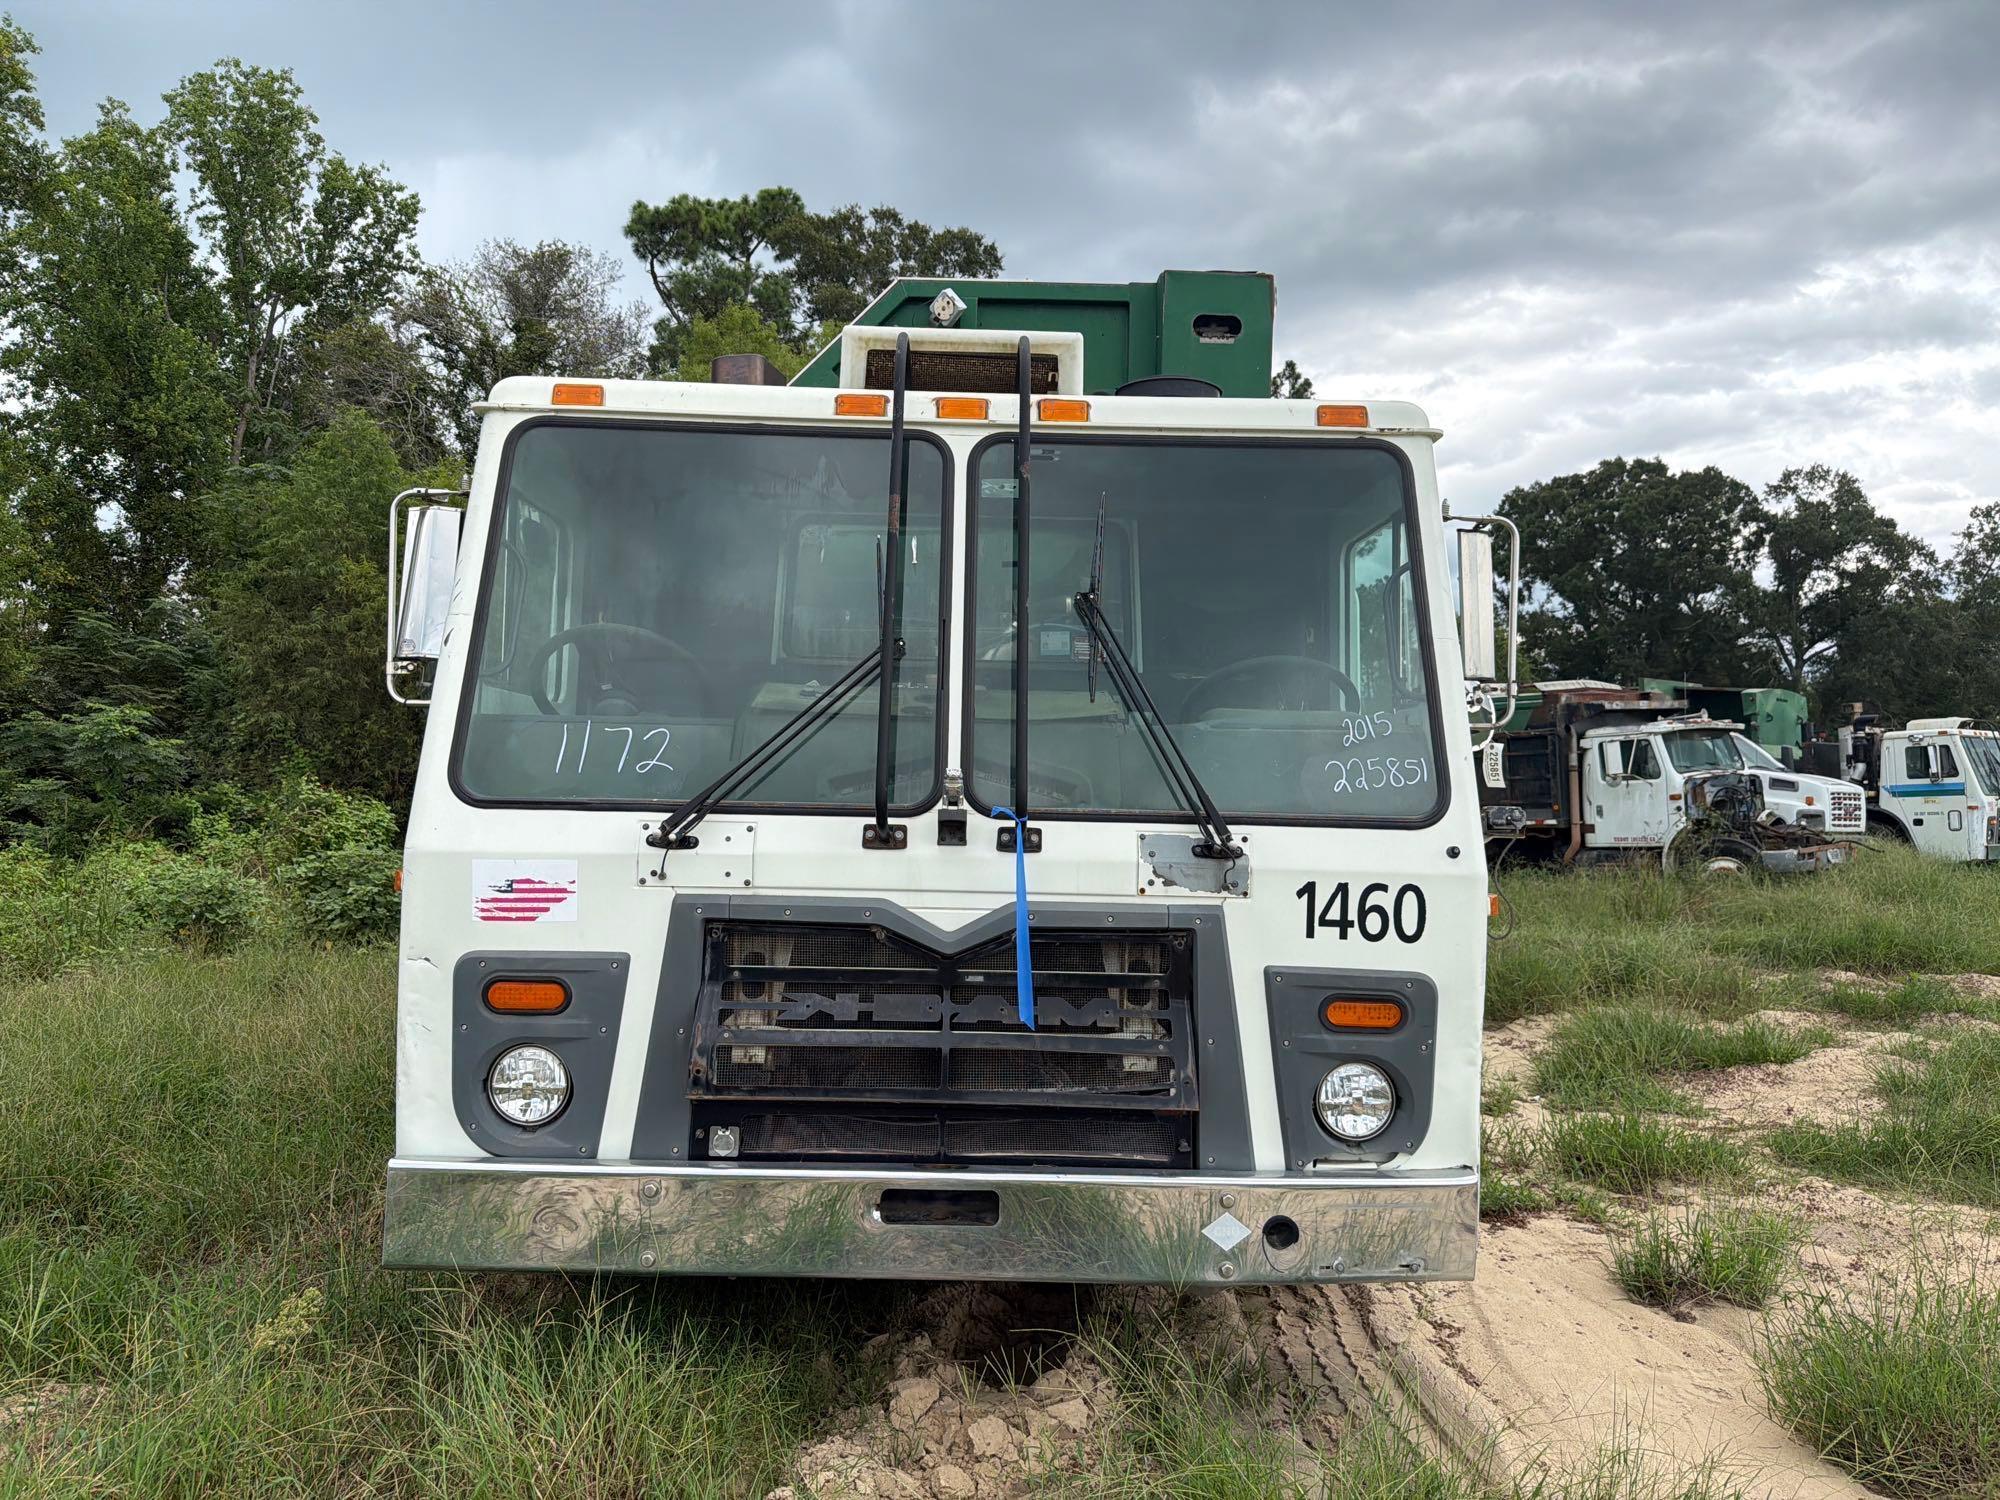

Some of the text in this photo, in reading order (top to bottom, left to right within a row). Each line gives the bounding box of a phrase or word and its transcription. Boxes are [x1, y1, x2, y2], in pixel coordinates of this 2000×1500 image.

[555, 719, 674, 774] 1172
[1341, 710, 1393, 747] 2015
[1324, 757, 1428, 794] 225851
[1489, 751, 1501, 782] 225851
[1295, 880, 1427, 944] 1460
